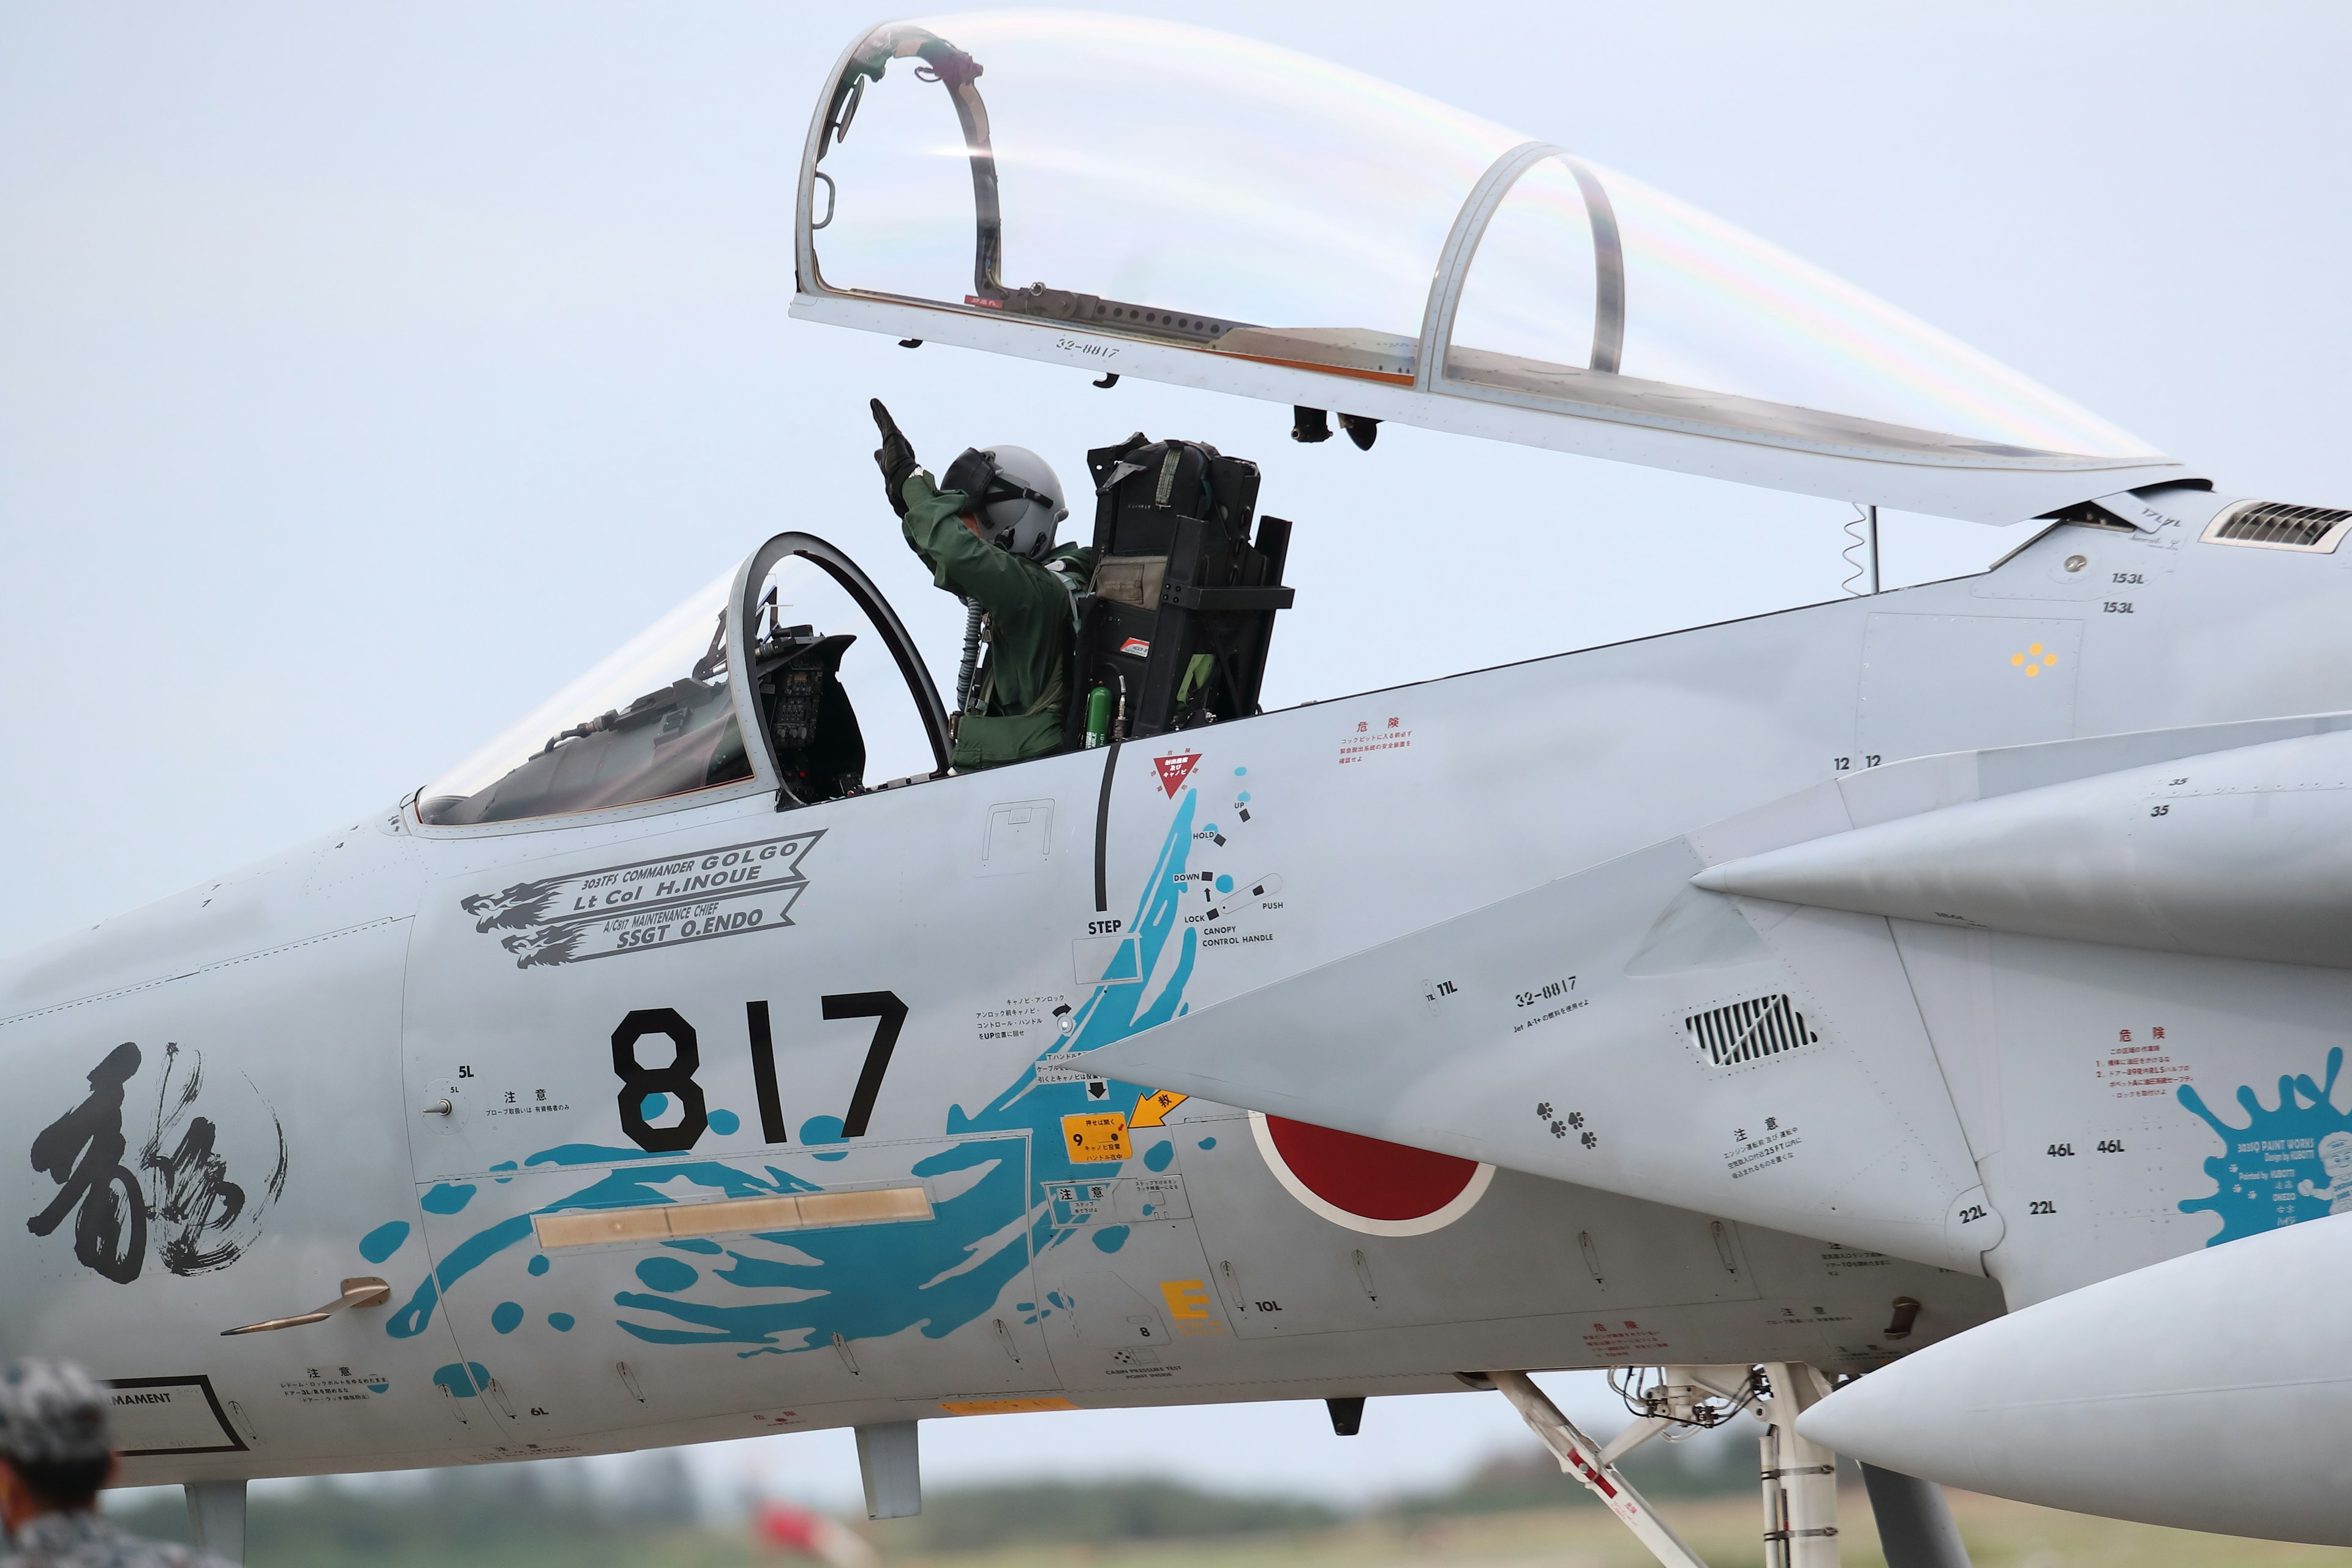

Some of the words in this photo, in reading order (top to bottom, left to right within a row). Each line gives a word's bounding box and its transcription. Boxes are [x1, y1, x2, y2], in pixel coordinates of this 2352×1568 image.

[1056, 339, 1120, 358] 32-8817
[2111, 572, 2144, 585] 153L
[2101, 601, 2135, 614] 153L
[1834, 757, 1849, 770] 12
[1866, 755, 1881, 767] 12
[1163, 769, 1187, 778] キャノピ
[2168, 777, 2189, 786] 35
[2150, 804, 2170, 817] 35
[1193, 831, 1215, 840] HOLD
[581, 874, 619, 890] 303TFS
[622, 861, 695, 883] COMMANDER
[701, 842, 798, 870] GOLGO
[1174, 873, 1200, 881] DOWN
[573, 895, 598, 911] Lt
[605, 886, 643, 905] Col
[655, 865, 762, 896] H.INOUE
[603, 919, 630, 933] A/C817
[631, 907, 692, 929] MAINTENANCE
[694, 902, 719, 918] CHIEF
[617, 924, 671, 949] SSGT
[681, 909, 763, 937] O.ENDO
[1088, 920, 1121, 935] STEP
[1203, 925, 1236, 935] CANOPY
[1202, 937, 1239, 947] CONTROL
[1437, 980, 1458, 997] 11L
[1515, 976, 1576, 1007] 32-8817
[1006, 995, 1064, 1006] キャノピ・アンロック
[978, 1019, 1042, 1028] コントロール・ハンドル
[1514, 1024, 1524, 1033] Jet
[979, 1030, 1024, 1040] をUP位置に回せ
[459, 1065, 474, 1078] 5L
[611, 990, 909, 1153] 817
[1158, 1094, 1172, 1107] 救
[1073, 1134, 1083, 1146] 9
[2097, 1140, 2125, 1153] 46L
[2261, 1140, 2285, 1151] PAINT
[2286, 1138, 2315, 1149] WORKS
[2046, 1143, 2075, 1156] 46L
[1959, 1204, 1987, 1224] 22L
[2029, 1201, 2056, 1215] 22L
[1256, 1300, 1282, 1312] 10L
[1140, 1327, 1150, 1336] 8
[530, 1407, 549, 1416] 6L
